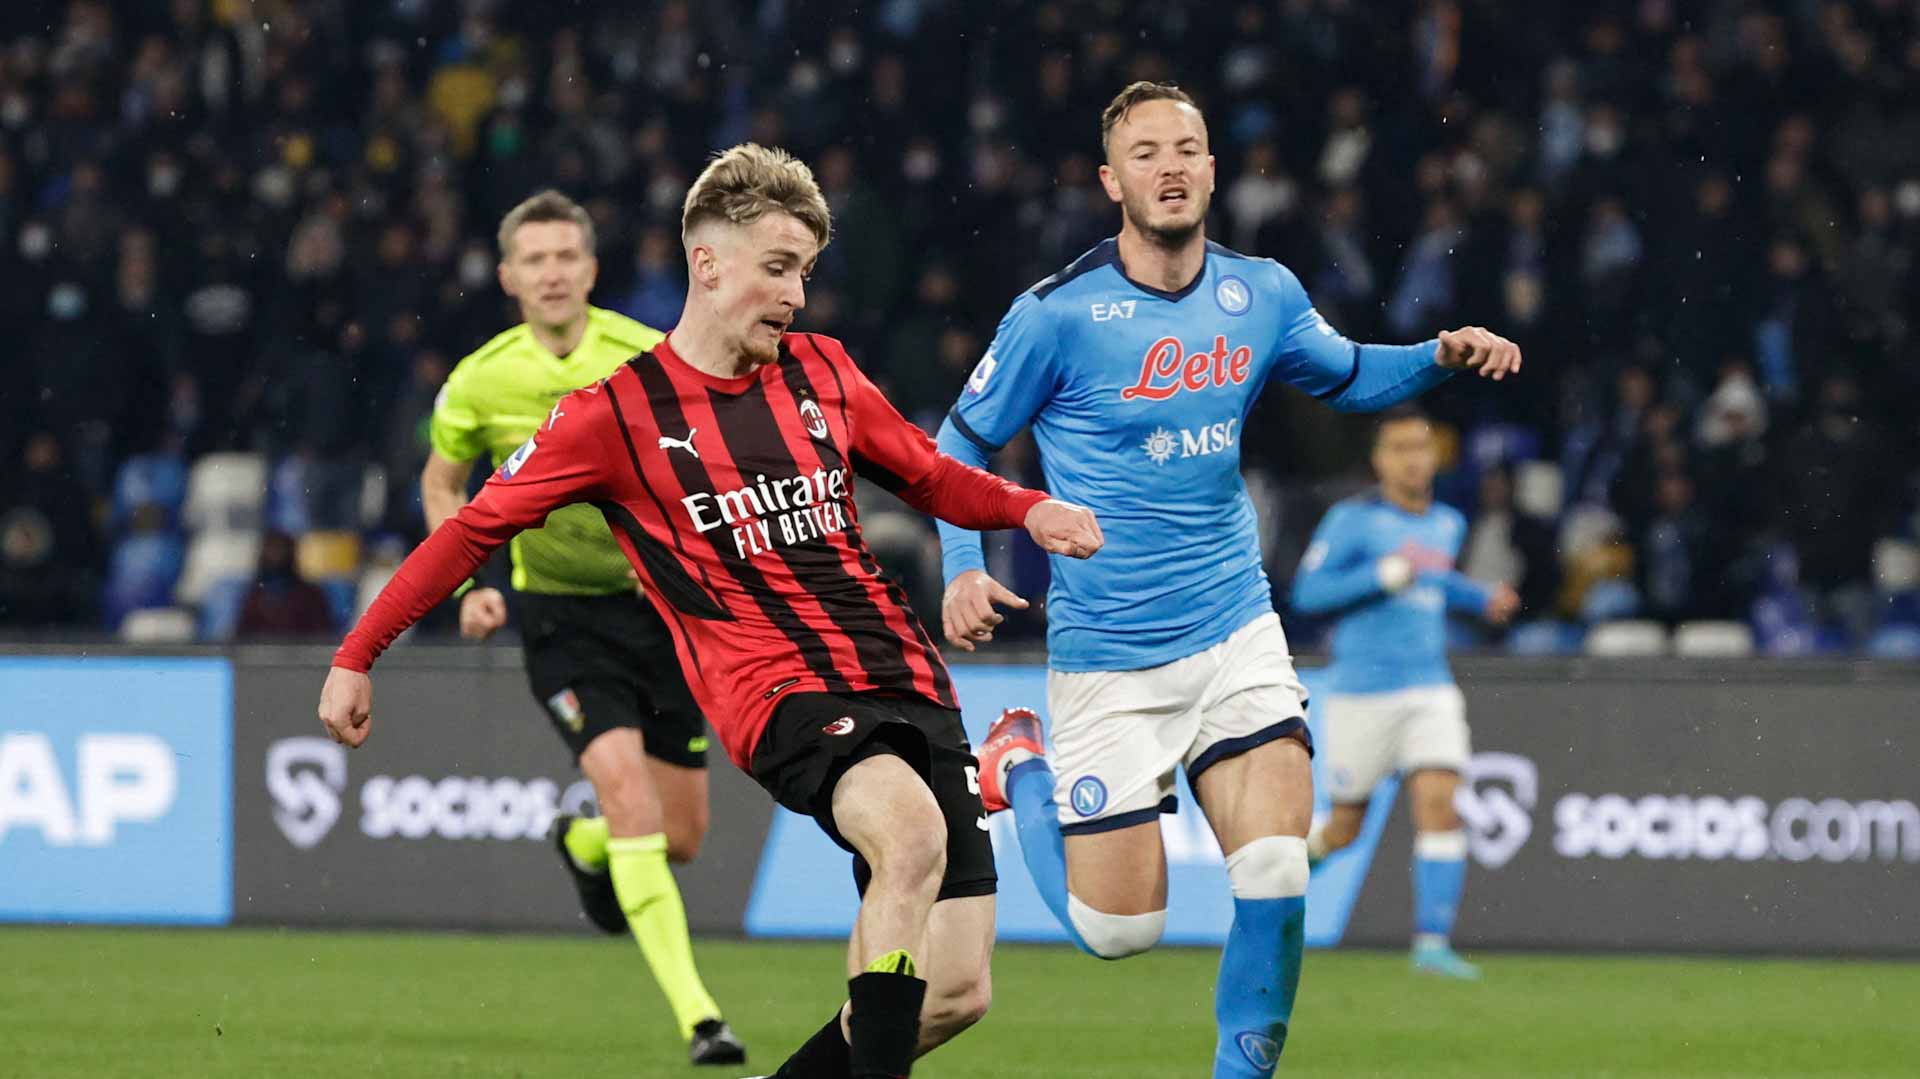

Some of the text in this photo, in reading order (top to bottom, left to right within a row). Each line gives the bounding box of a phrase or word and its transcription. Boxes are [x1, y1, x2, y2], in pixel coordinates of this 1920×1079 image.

[1091, 300, 1137, 321] EA7
[1122, 335, 1252, 401] Lete
[1180, 418, 1237, 458] MSC
[680, 466, 849, 533] Emirates
[732, 501, 847, 560] FLY BETTER
